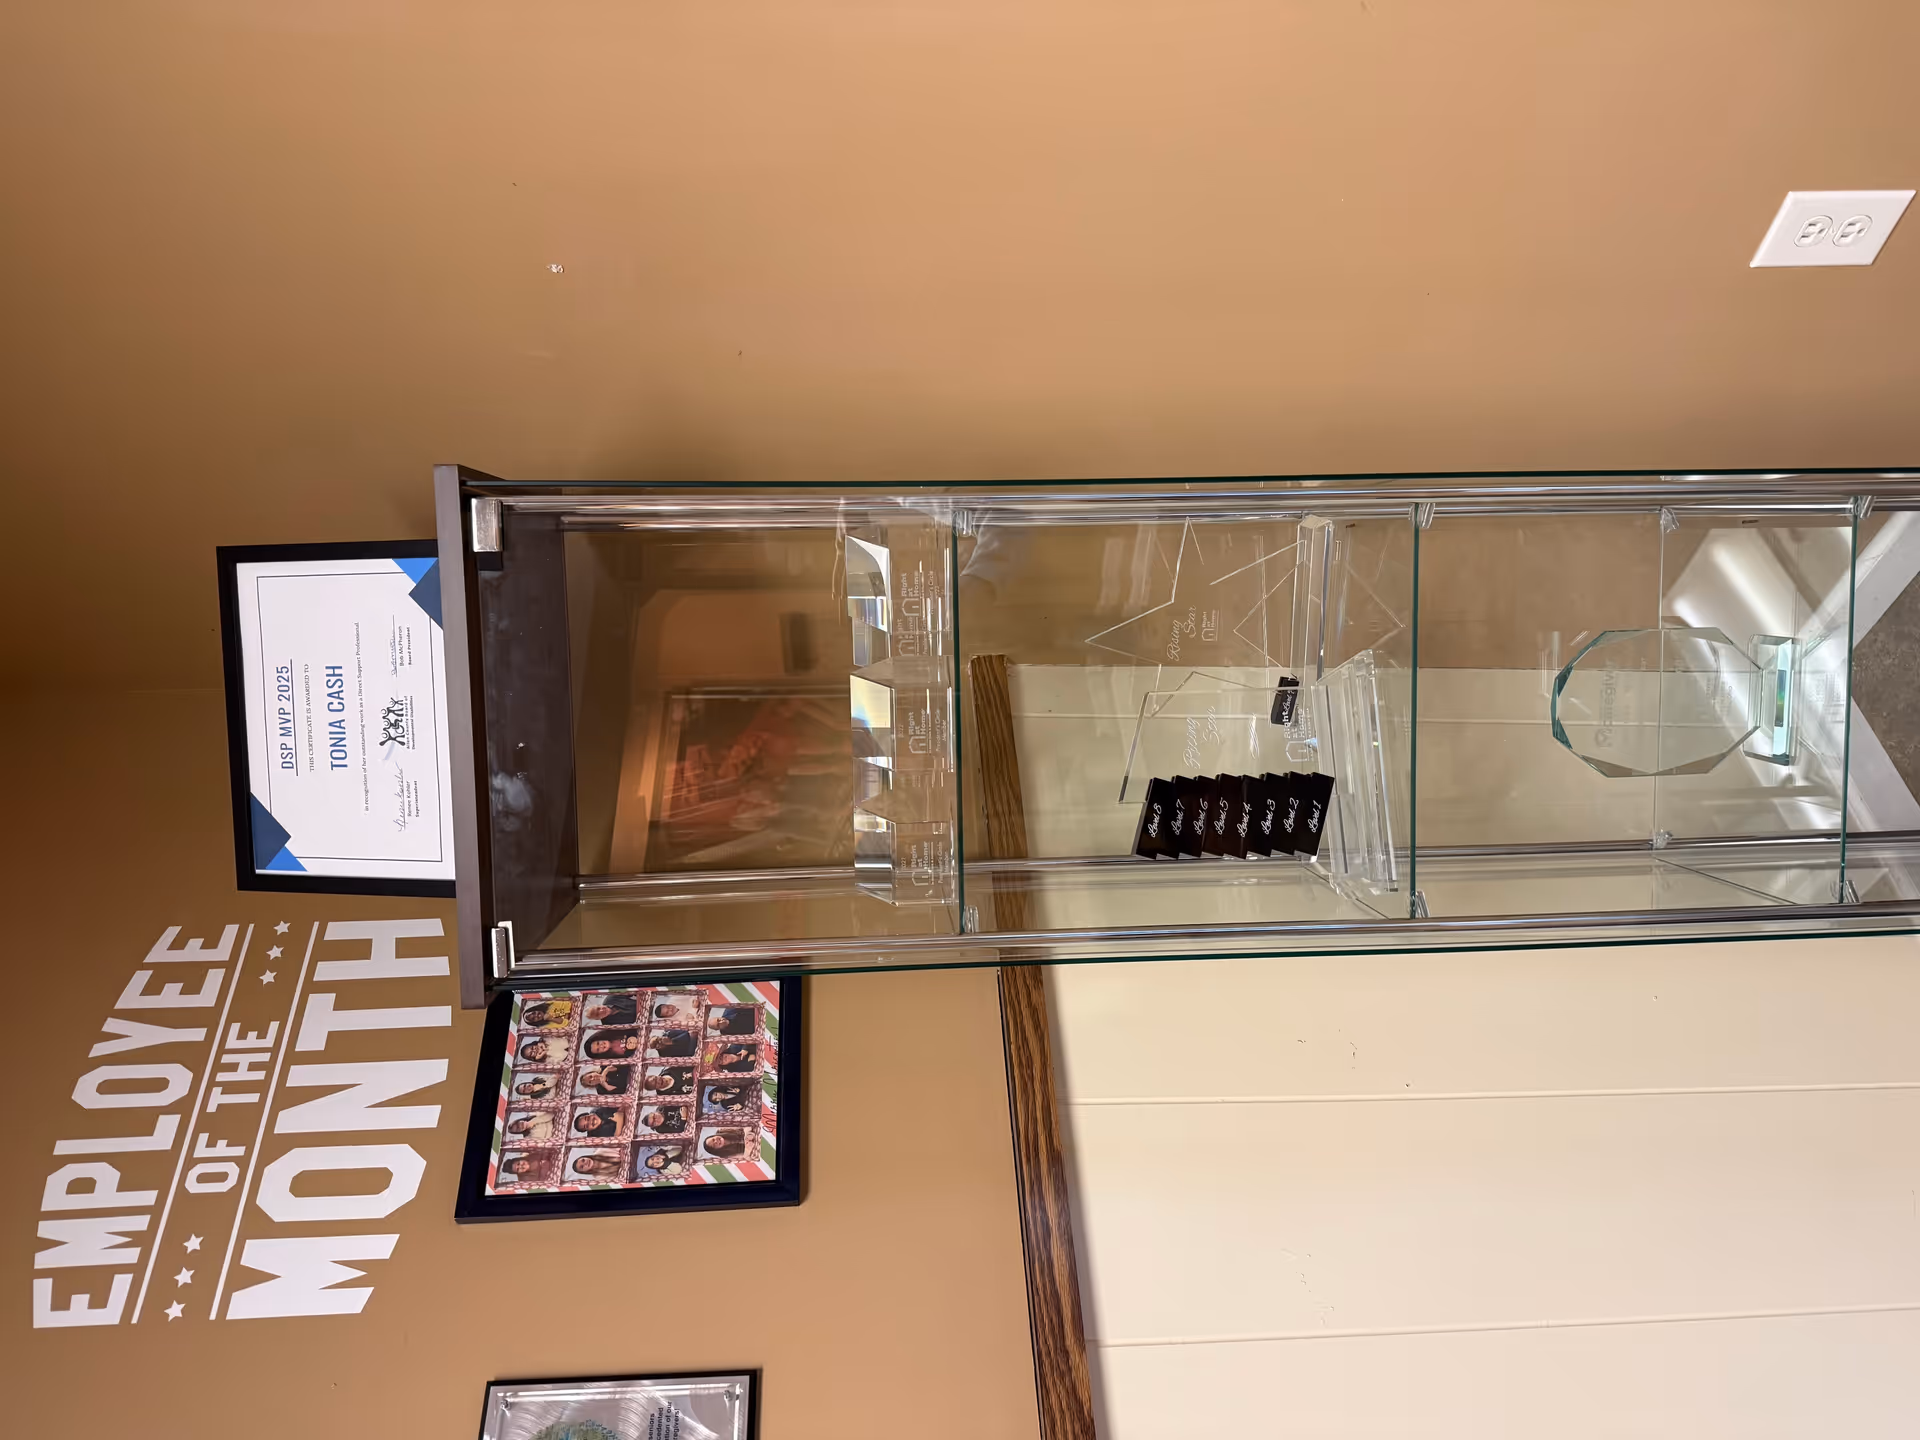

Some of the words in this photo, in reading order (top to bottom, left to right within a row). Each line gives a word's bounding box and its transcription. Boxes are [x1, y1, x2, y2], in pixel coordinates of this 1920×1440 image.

[908, 588, 913, 597] at
[1183, 605, 1196, 638] Star
[1167, 620, 1183, 661] Rising
[276, 666, 290, 702] 2025
[304, 664, 310, 673] TO
[325, 666, 345, 712] CASH
[278, 708, 292, 737] MVP
[306, 715, 314, 756] CERTIFICATE
[915, 726, 920, 735] at
[1282, 711, 1292, 738] Right
[280, 742, 294, 769] DSP
[328, 718, 348, 770] TONIA
[1153, 803, 1162, 814] 8
[1176, 798, 1185, 809] 7
[1193, 810, 1205, 835] Level
[1200, 798, 1208, 810] 6
[1214, 810, 1226, 835] Level
[1220, 797, 1228, 810] 5
[1237, 813, 1249, 837] Level
[1243, 802, 1252, 813] 4
[1261, 810, 1273, 835] Level
[1267, 799, 1275, 810] 3
[1283, 808, 1295, 833] Level
[1290, 797, 1299, 809] 2
[1313, 800, 1321, 809] 1
[1148, 813, 1160, 838] Level
[1171, 810, 1183, 835] Level
[1308, 808, 1320, 833] Level
[206, 1020, 280, 1112] THE
[33, 924, 239, 1328] EMPLOYEE
[226, 918, 451, 1320] MONTH
[184, 1133, 246, 1194] OF
[656, 1408, 664, 1440] cedented
[672, 1409, 680, 1440] regivers!
